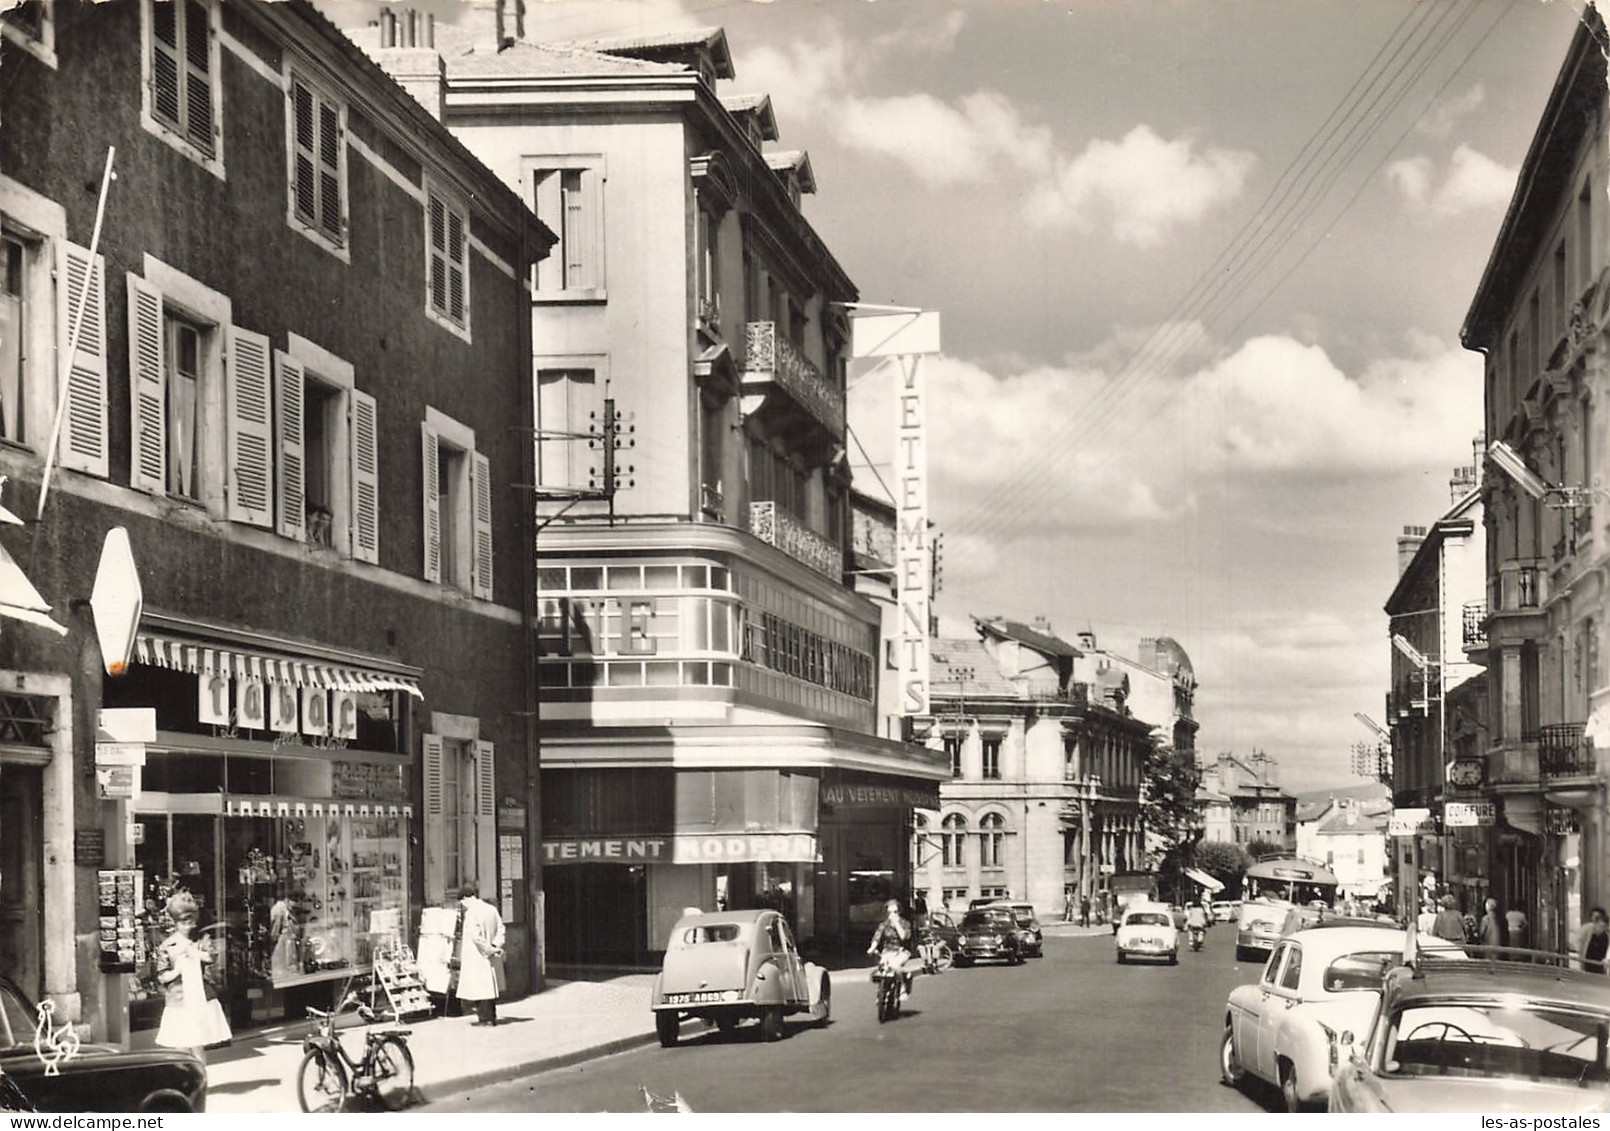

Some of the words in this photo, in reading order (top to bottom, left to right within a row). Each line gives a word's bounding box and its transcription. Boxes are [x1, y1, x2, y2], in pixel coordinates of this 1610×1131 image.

[898, 354, 925, 713] VETEMENTS
[208, 677, 354, 734] tabac
[1448, 805, 1495, 817] COIFFURE
[542, 841, 665, 859] TEMENT
